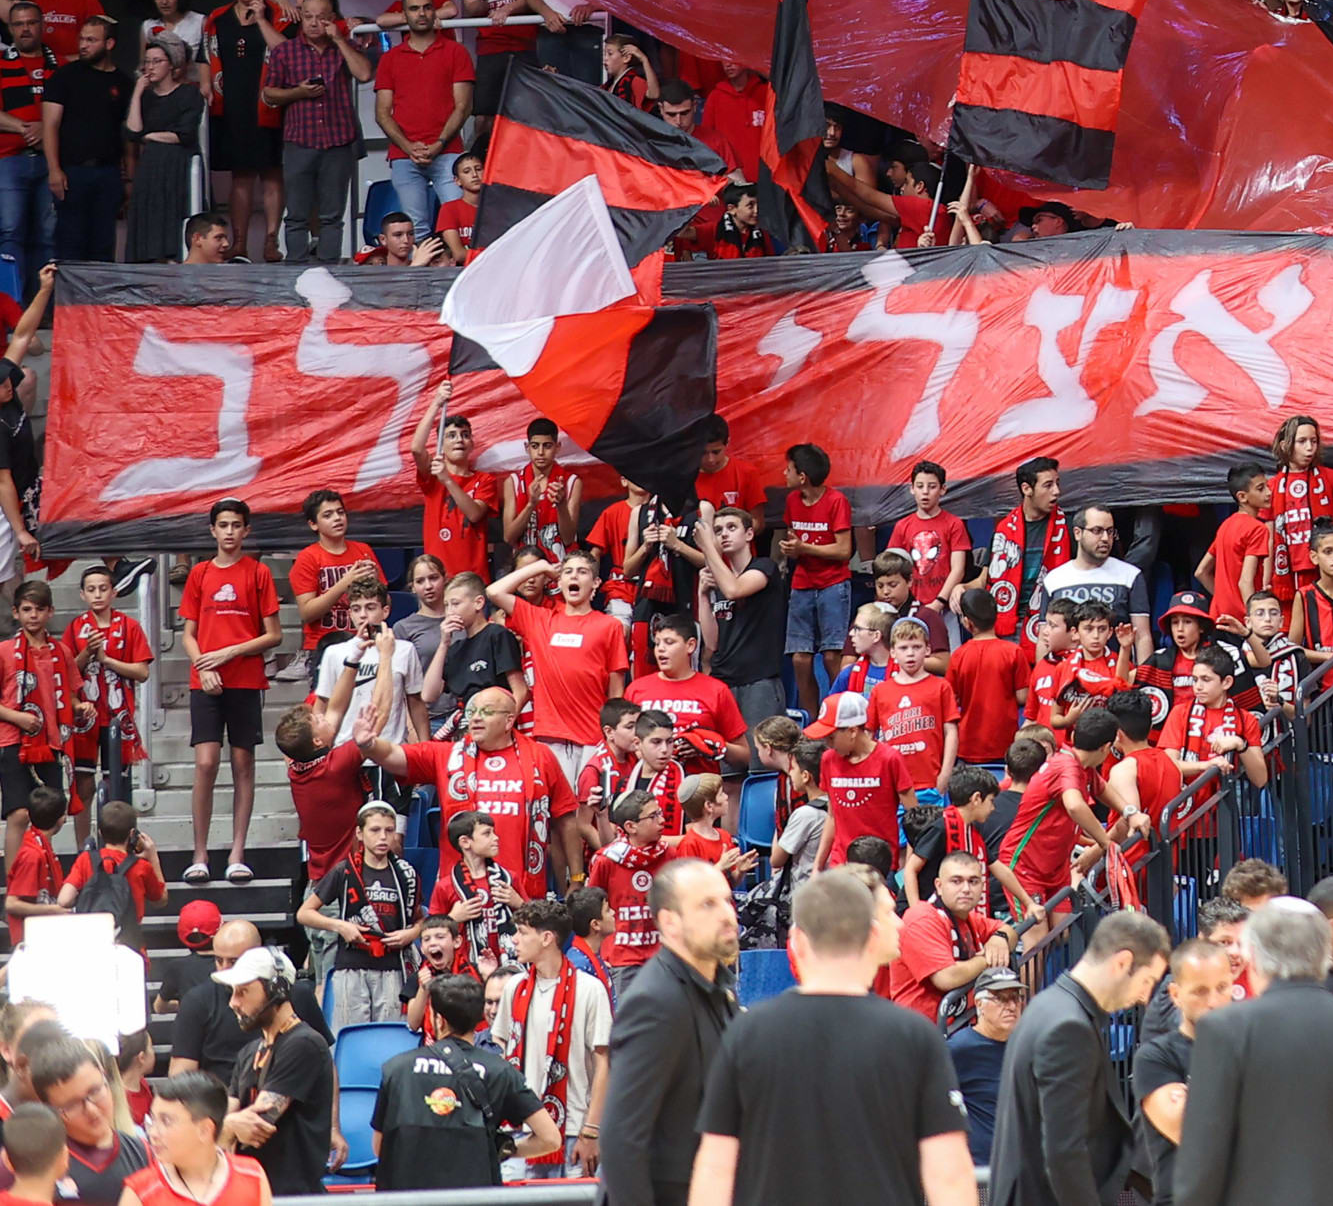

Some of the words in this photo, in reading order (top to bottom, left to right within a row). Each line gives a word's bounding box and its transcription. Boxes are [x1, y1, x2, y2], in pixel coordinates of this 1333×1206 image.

[757, 250, 1316, 463] אצלי
[641, 699, 703, 715] HAPOEL
[831, 777, 880, 788] JERUSALEM
